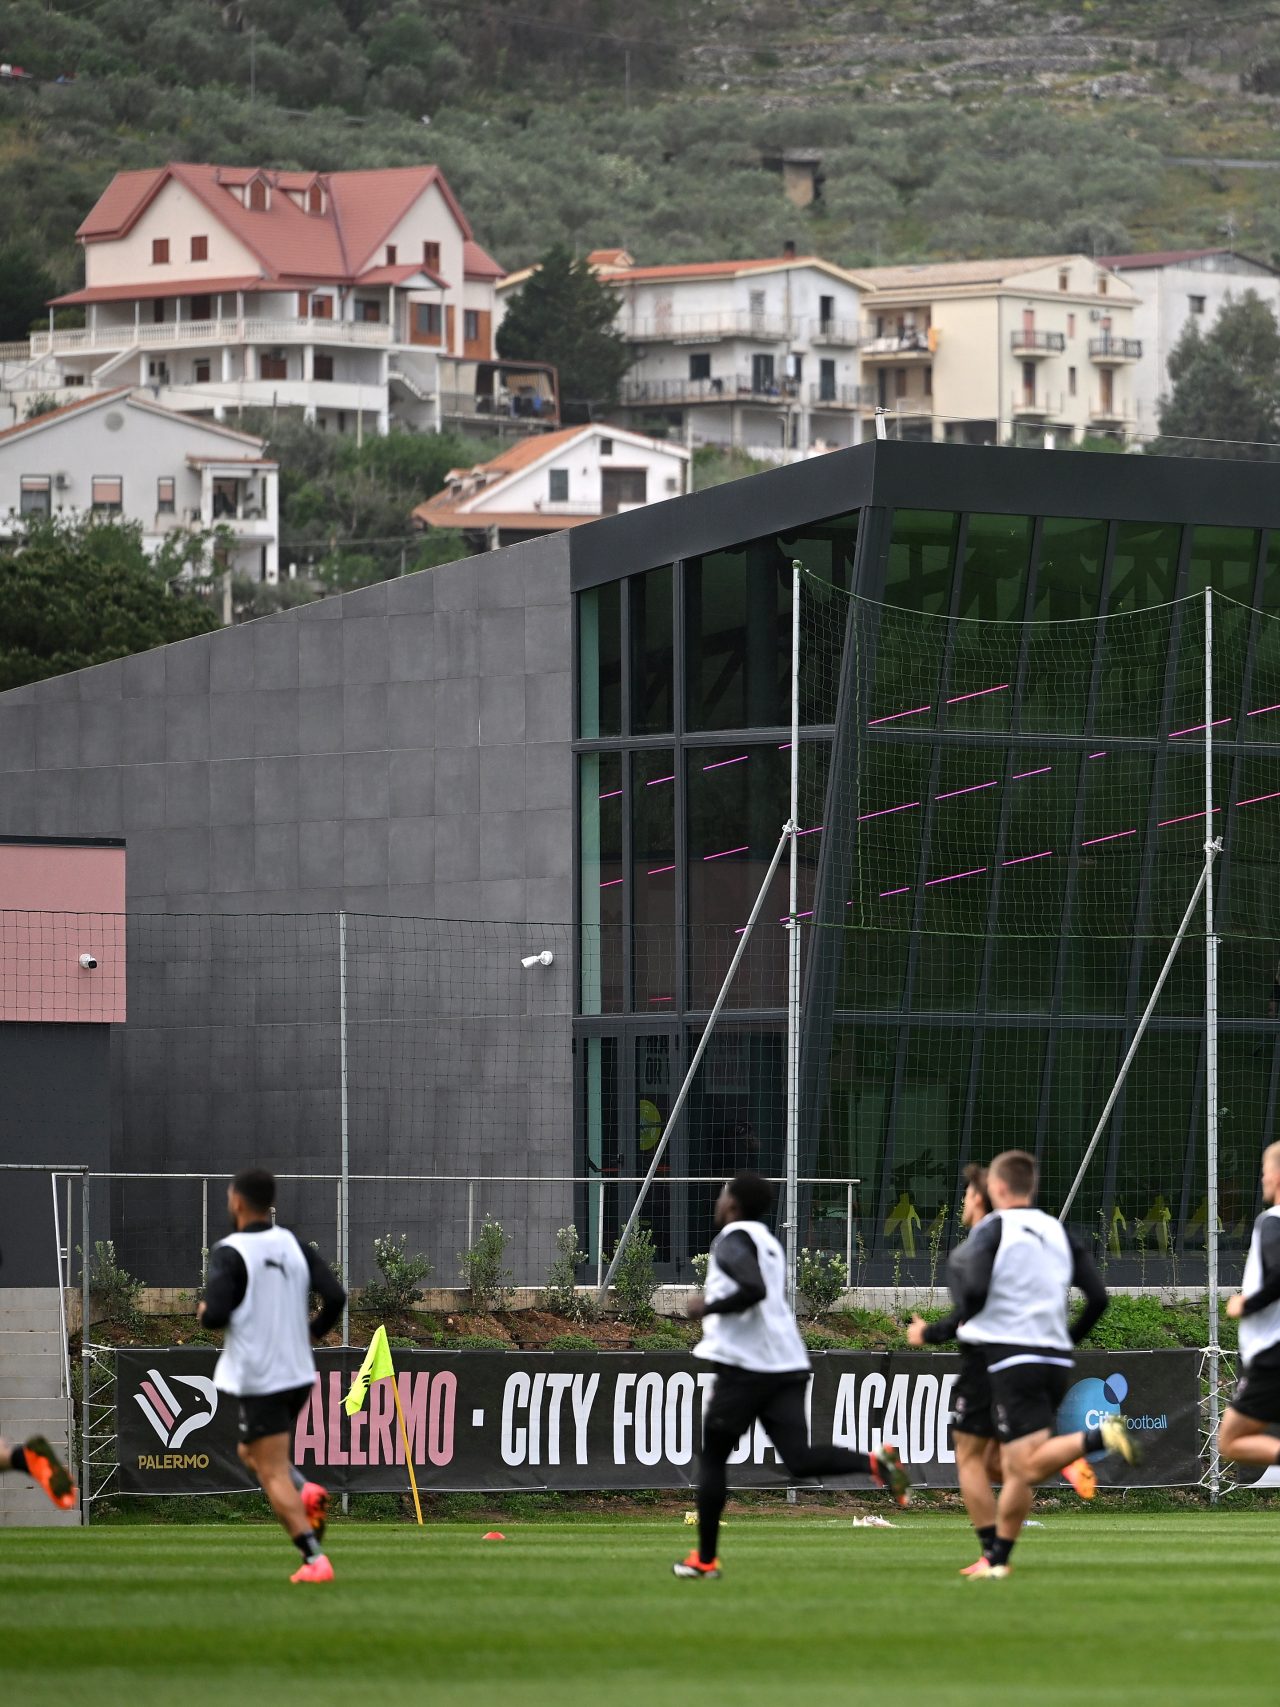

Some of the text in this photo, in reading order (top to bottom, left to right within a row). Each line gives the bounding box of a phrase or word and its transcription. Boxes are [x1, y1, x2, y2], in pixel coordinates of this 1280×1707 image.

[294, 1371, 458, 1467] ALERMO
[501, 1371, 600, 1467] CITY
[832, 1372, 961, 1464] ACADE
[137, 1453, 210, 1470] PALERMO
